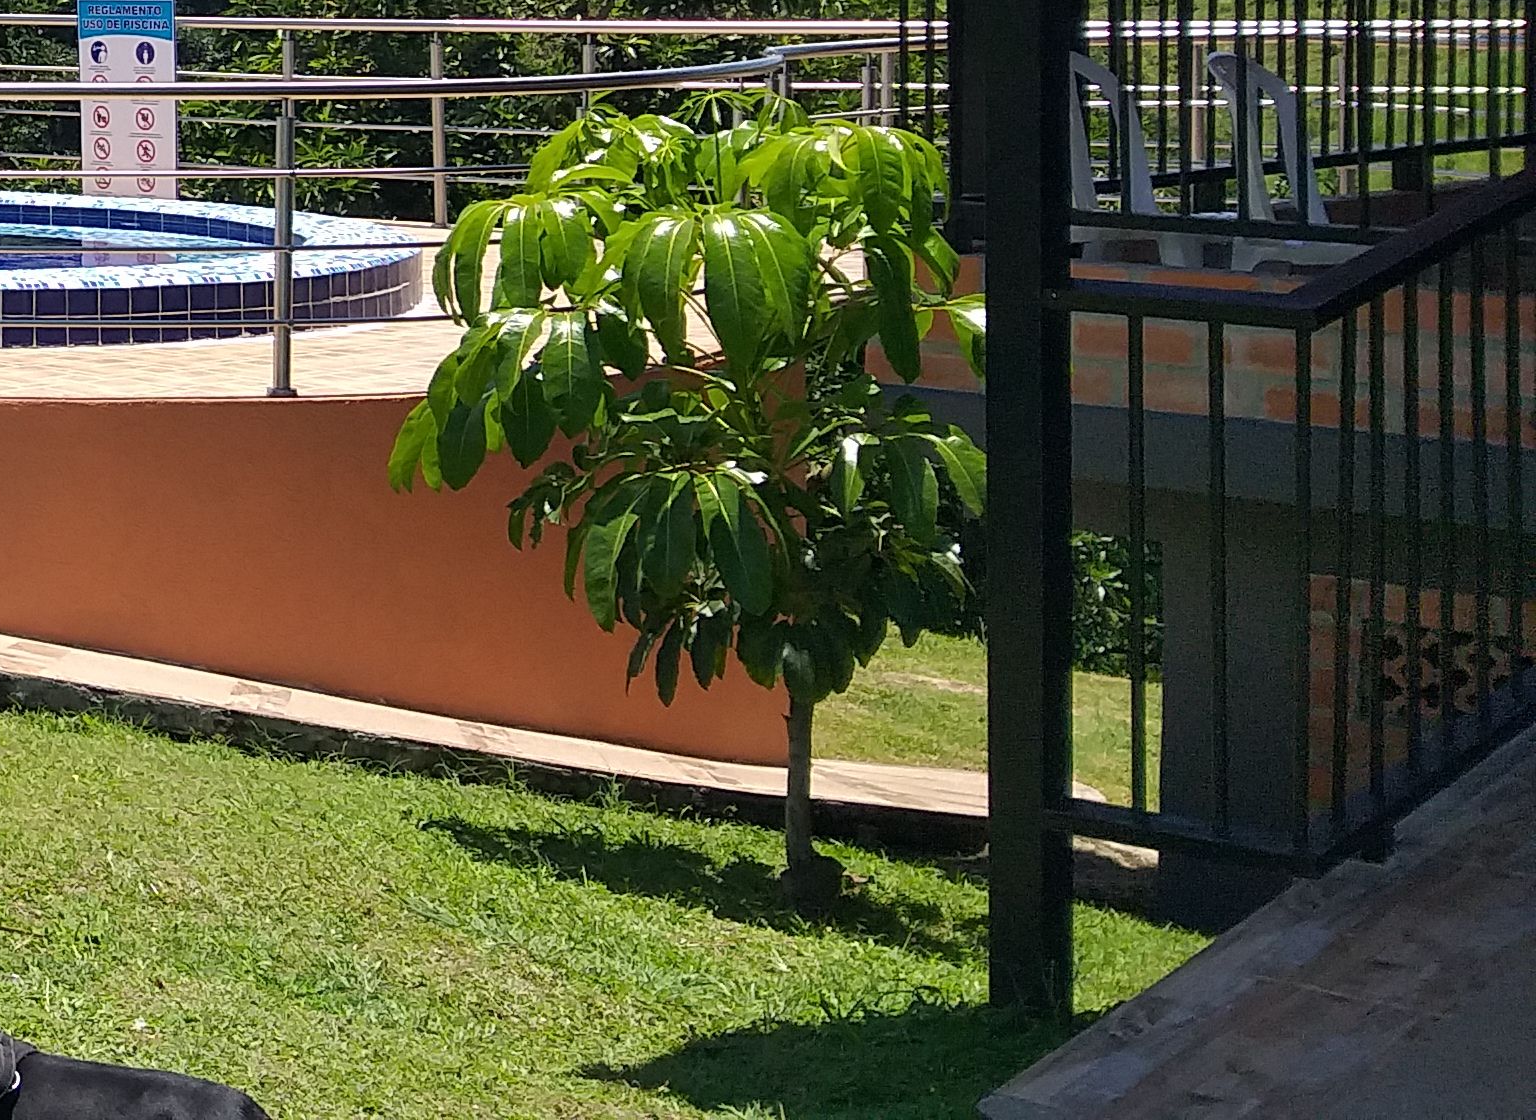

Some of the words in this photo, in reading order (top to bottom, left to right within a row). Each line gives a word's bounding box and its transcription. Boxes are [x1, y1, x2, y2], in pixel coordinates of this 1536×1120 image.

[87, 5, 162, 16] REGLAMENTO
[83, 19, 103, 29] USO
[107, 20, 120, 29] DE
[123, 20, 170, 30] PISCINA
